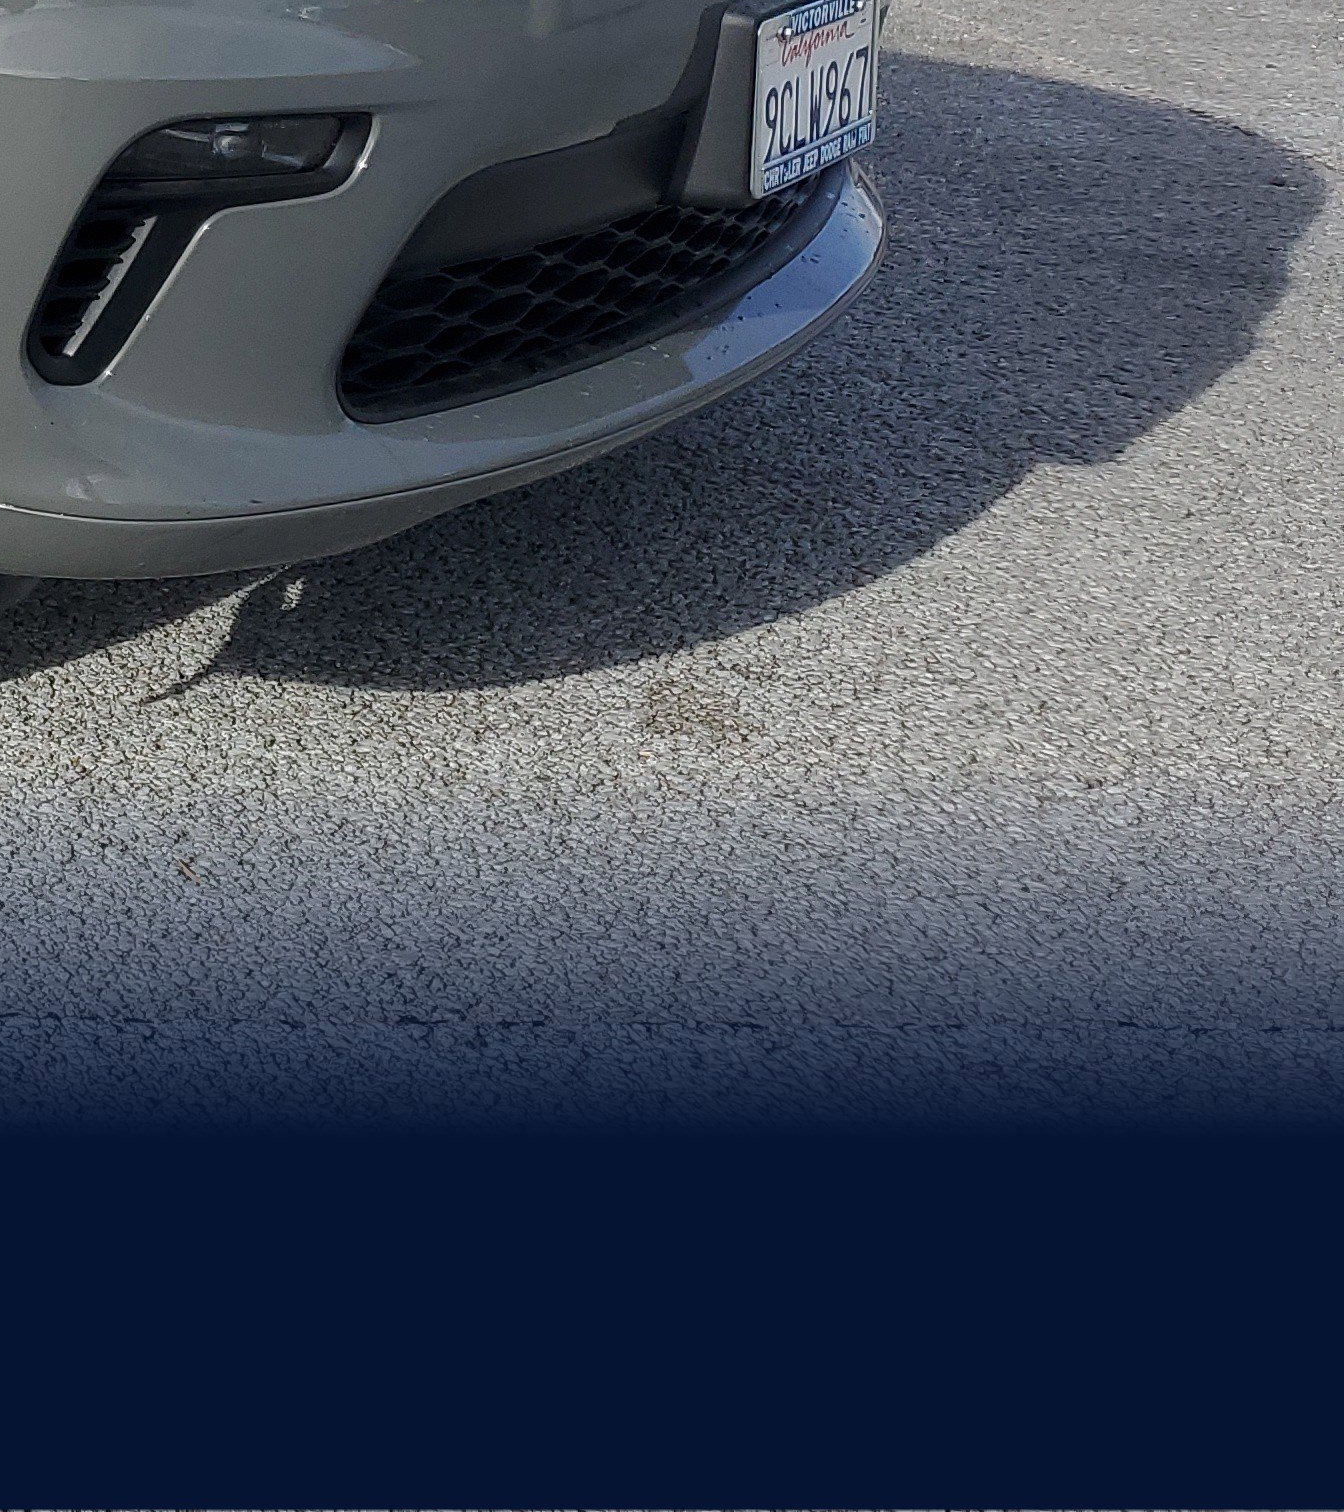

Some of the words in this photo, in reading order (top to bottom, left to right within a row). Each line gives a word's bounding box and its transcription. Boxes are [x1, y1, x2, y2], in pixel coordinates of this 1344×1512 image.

[764, 45, 869, 163] 9CLW967
[803, 148, 819, 174] JEEP
[820, 136, 842, 164] DODGE
